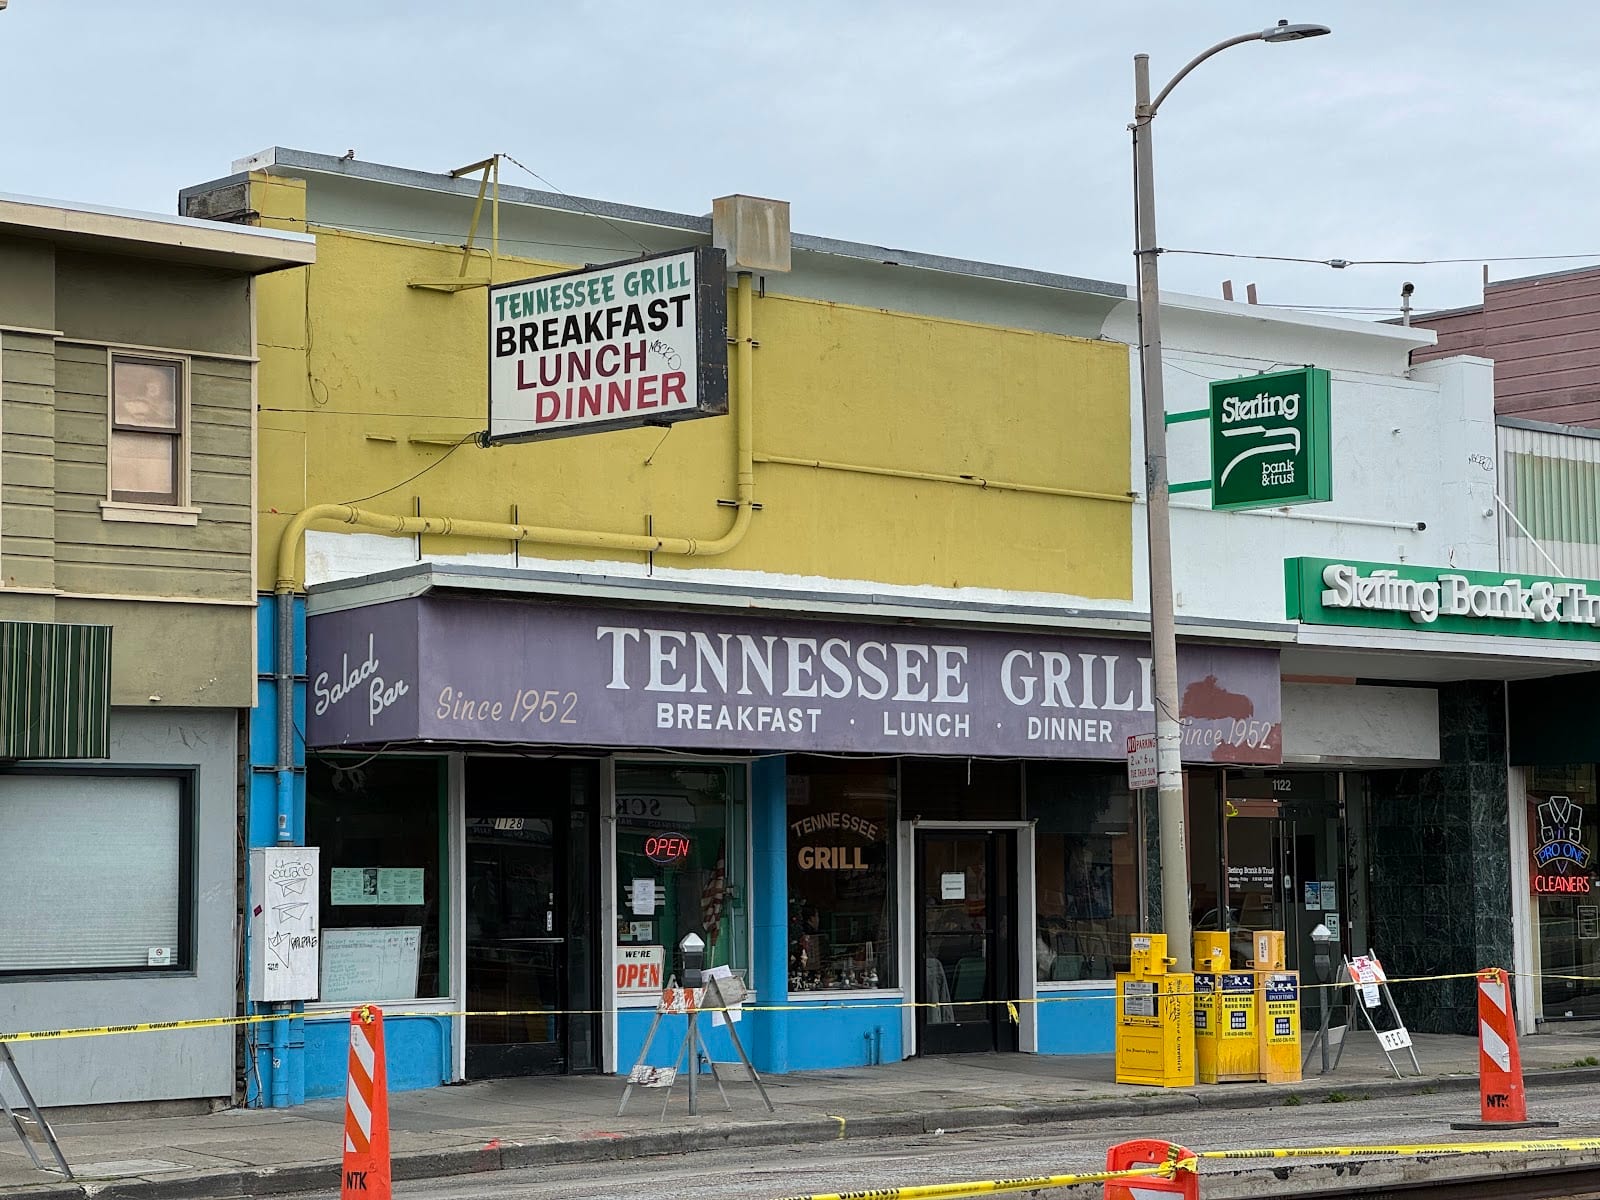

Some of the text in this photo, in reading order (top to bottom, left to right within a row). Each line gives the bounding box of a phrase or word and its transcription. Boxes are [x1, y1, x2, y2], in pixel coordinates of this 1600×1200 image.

[495, 261, 691, 322] TENNESSEE GRILL
[496, 294, 691, 358] BREAKFAST
[517, 339, 647, 390] LUNCH
[535, 371, 687, 424] DINNER
[1222, 392, 1300, 424] Sterling
[1262, 459, 1294, 475] bank
[1438, 574, 1535, 619] Bank
[1530, 581, 1562, 622] &
[314, 633, 379, 717] Salad
[597, 626, 969, 704] TENNESSEE
[368, 677, 409, 726] Bar
[436, 686, 578, 724] Since 1952
[656, 702, 1113, 743] BREAKFAST LUNCH DINNER
[1229, 719, 1273, 750] 1952
[1272, 779, 1291, 791] 1122
[496, 818, 523, 829] 1128
[791, 812, 879, 840] TENNESSEE
[645, 837, 690, 857] OPEN
[798, 847, 869, 870] GRILL
[1538, 843, 1585, 864] PRO ONE
[1535, 875, 1590, 892] CLEANERS
[625, 950, 651, 958] WE'RE
[616, 963, 660, 988] OPEN
[1487, 1094, 1509, 1107] NTK
[347, 1172, 367, 1190] NTK
